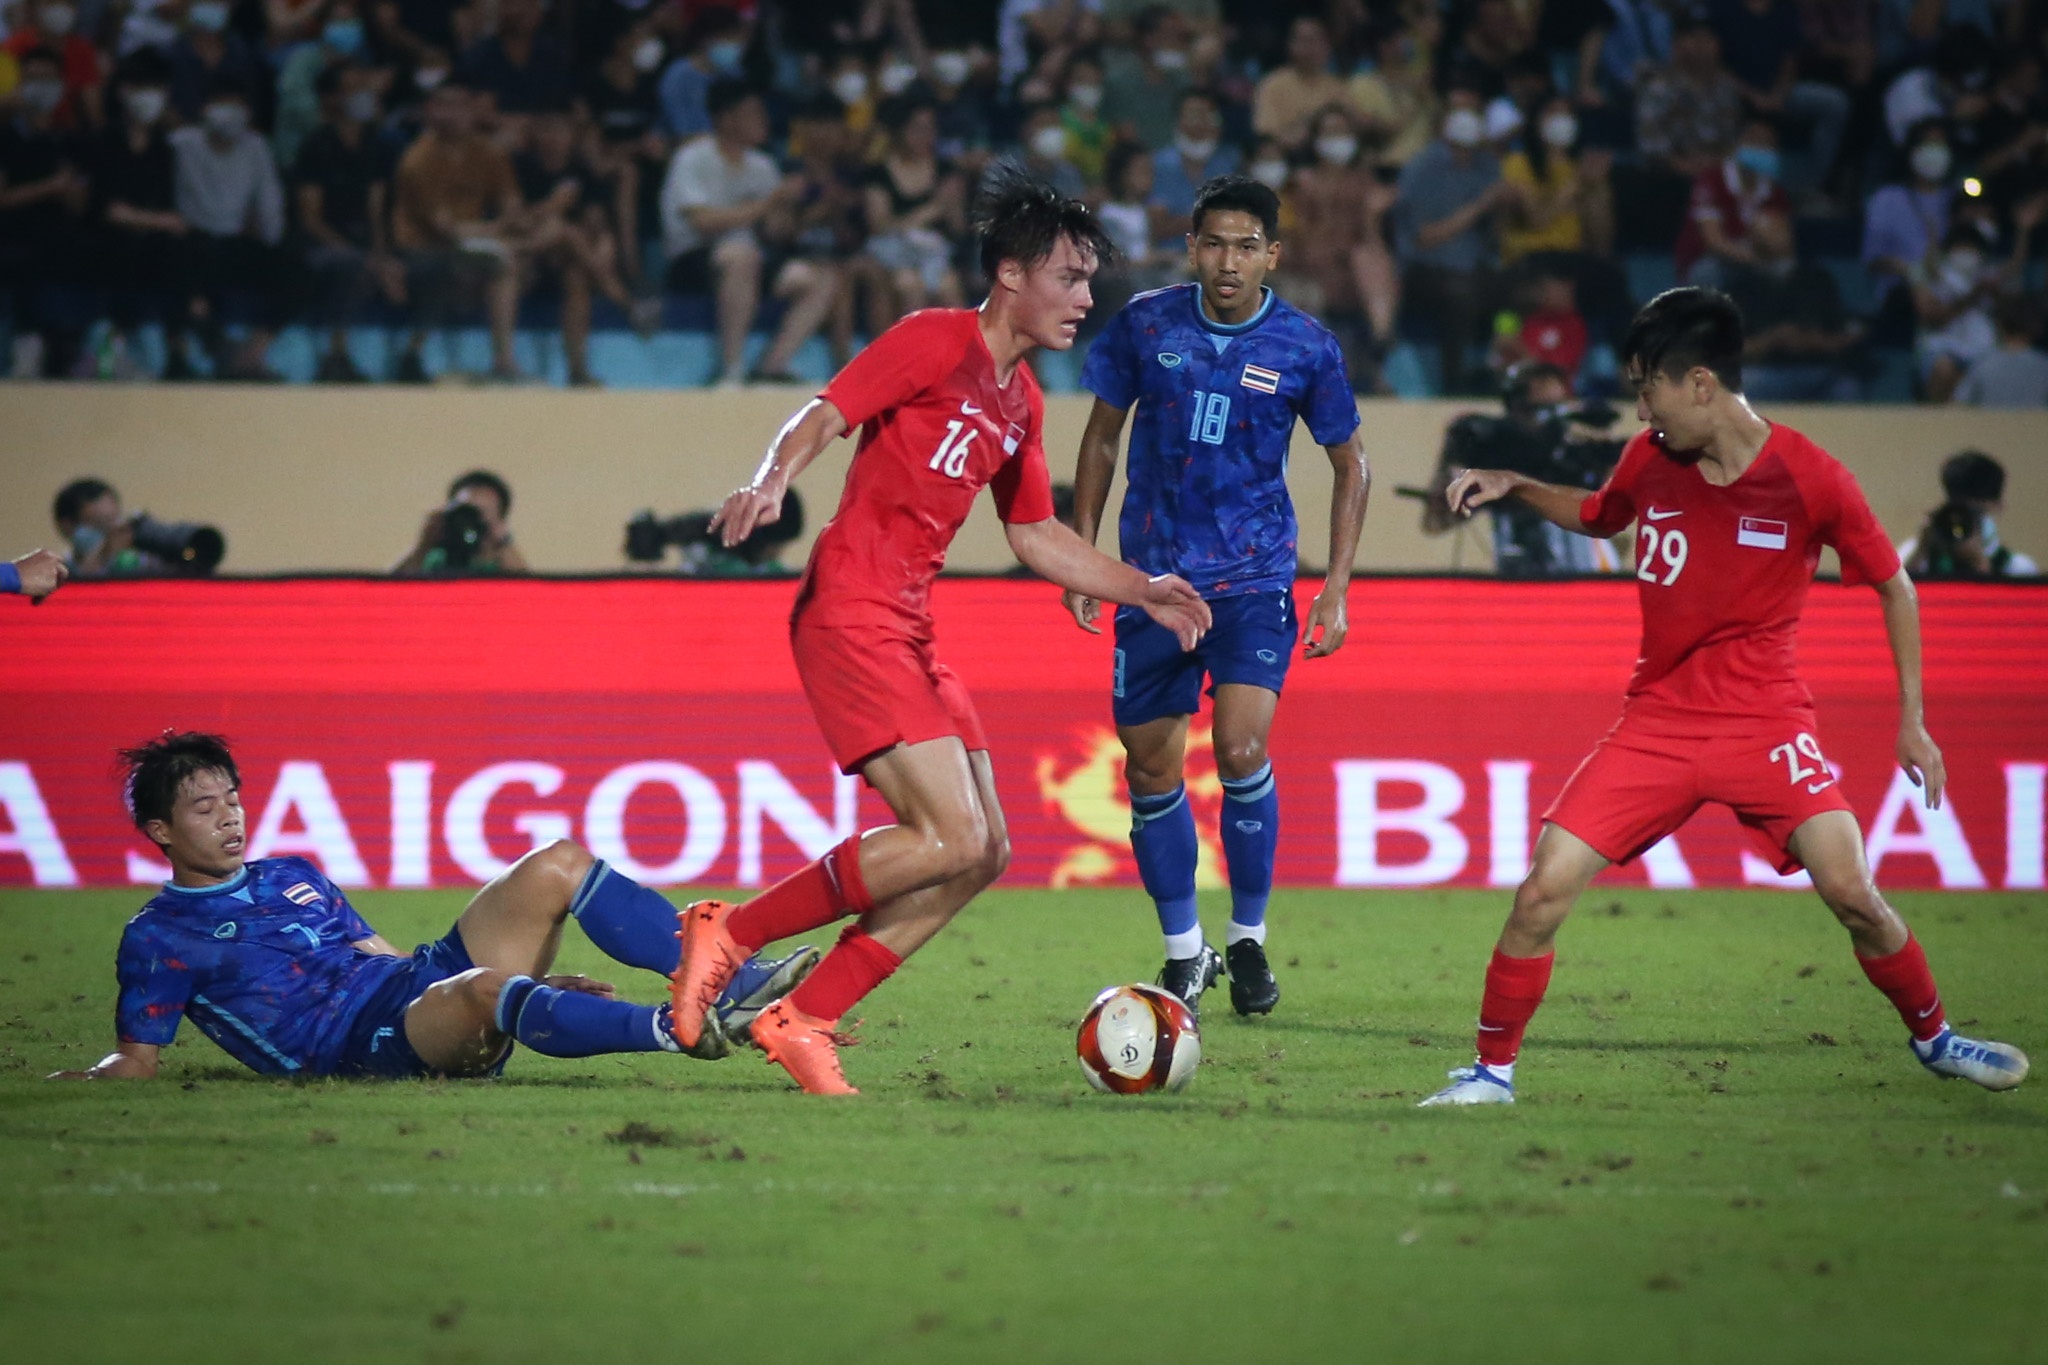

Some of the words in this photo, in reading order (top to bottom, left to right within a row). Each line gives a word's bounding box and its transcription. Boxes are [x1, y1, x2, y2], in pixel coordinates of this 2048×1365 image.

[1189, 390, 1230, 445] 18
[929, 420, 978, 478] 16
[1637, 525, 1688, 587] 29
[1769, 732, 1829, 785] 29
[126, 761, 858, 888] AIGON
[1740, 760, 2048, 888] AI
